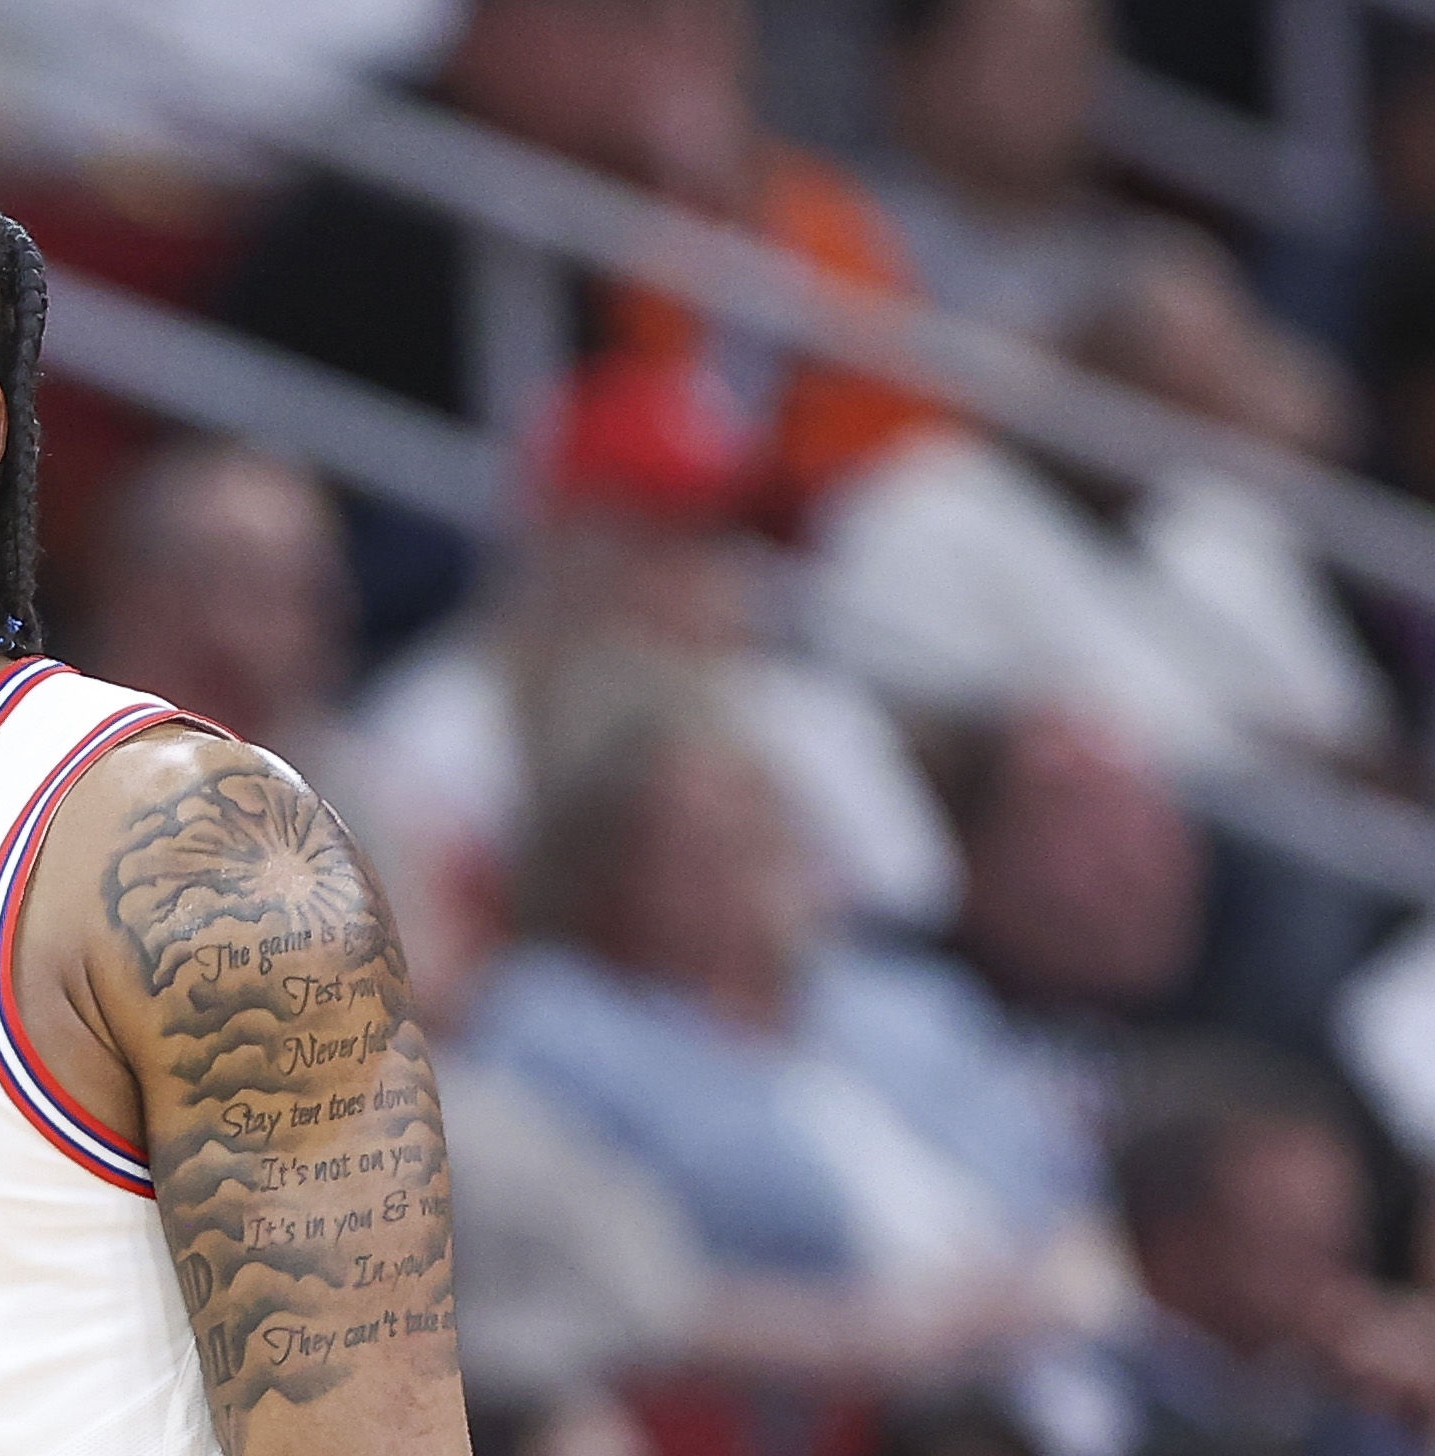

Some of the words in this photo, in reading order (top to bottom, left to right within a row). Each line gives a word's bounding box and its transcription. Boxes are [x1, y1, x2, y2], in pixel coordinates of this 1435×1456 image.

[194, 940, 250, 984] The
[321, 918, 335, 944] is
[282, 974, 343, 1016] Test
[283, 1032, 359, 1077] Never
[221, 1103, 283, 1146] Stay
[290, 1101, 322, 1128] ten
[329, 1093, 366, 1121] toes
[260, 1157, 309, 1193] It's
[314, 1153, 351, 1183] not
[359, 1151, 384, 1173] on
[247, 1217, 295, 1251] It's
[305, 1216, 325, 1241] in
[333, 1208, 374, 1245] you
[382, 1190, 410, 1222] &
[352, 1254, 385, 1289] In
[262, 1325, 337, 1366] They
[344, 1310, 399, 1349] can't
